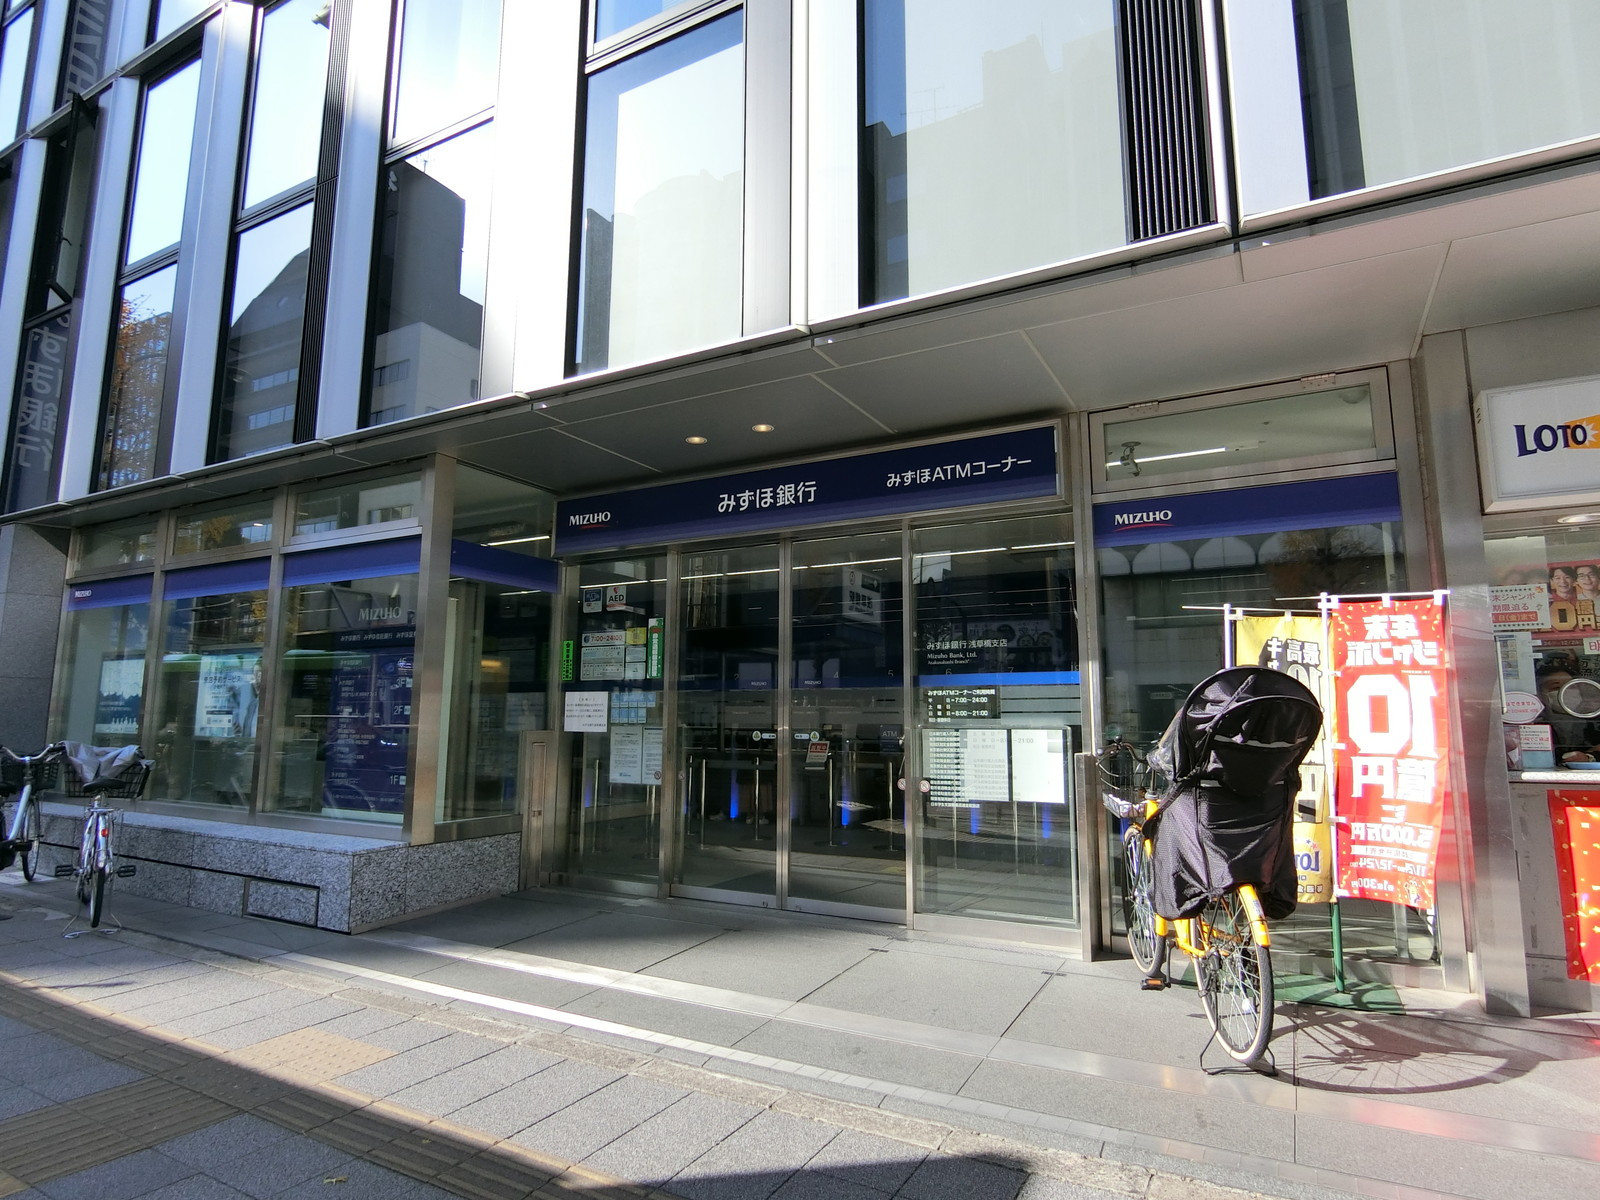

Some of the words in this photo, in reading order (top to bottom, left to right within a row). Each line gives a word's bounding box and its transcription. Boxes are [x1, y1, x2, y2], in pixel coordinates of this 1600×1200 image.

[1513, 424, 1587, 457] LOTO
[886, 455, 1032, 487] みずほATMコーナー
[717, 481, 817, 513] みずほ銀行
[569, 511, 611, 526] MIZUHO
[1114, 509, 1172, 525] MIZUHO
[74, 590, 92, 598] MIZUHO
[608, 594, 625, 602] AED
[1493, 603, 1529, 612] 期限迫る
[359, 607, 401, 621] MIZUHO
[926, 640, 967, 650] みずほ銀行
[394, 705, 404, 715] 2F
[389, 774, 399, 785] 1F
